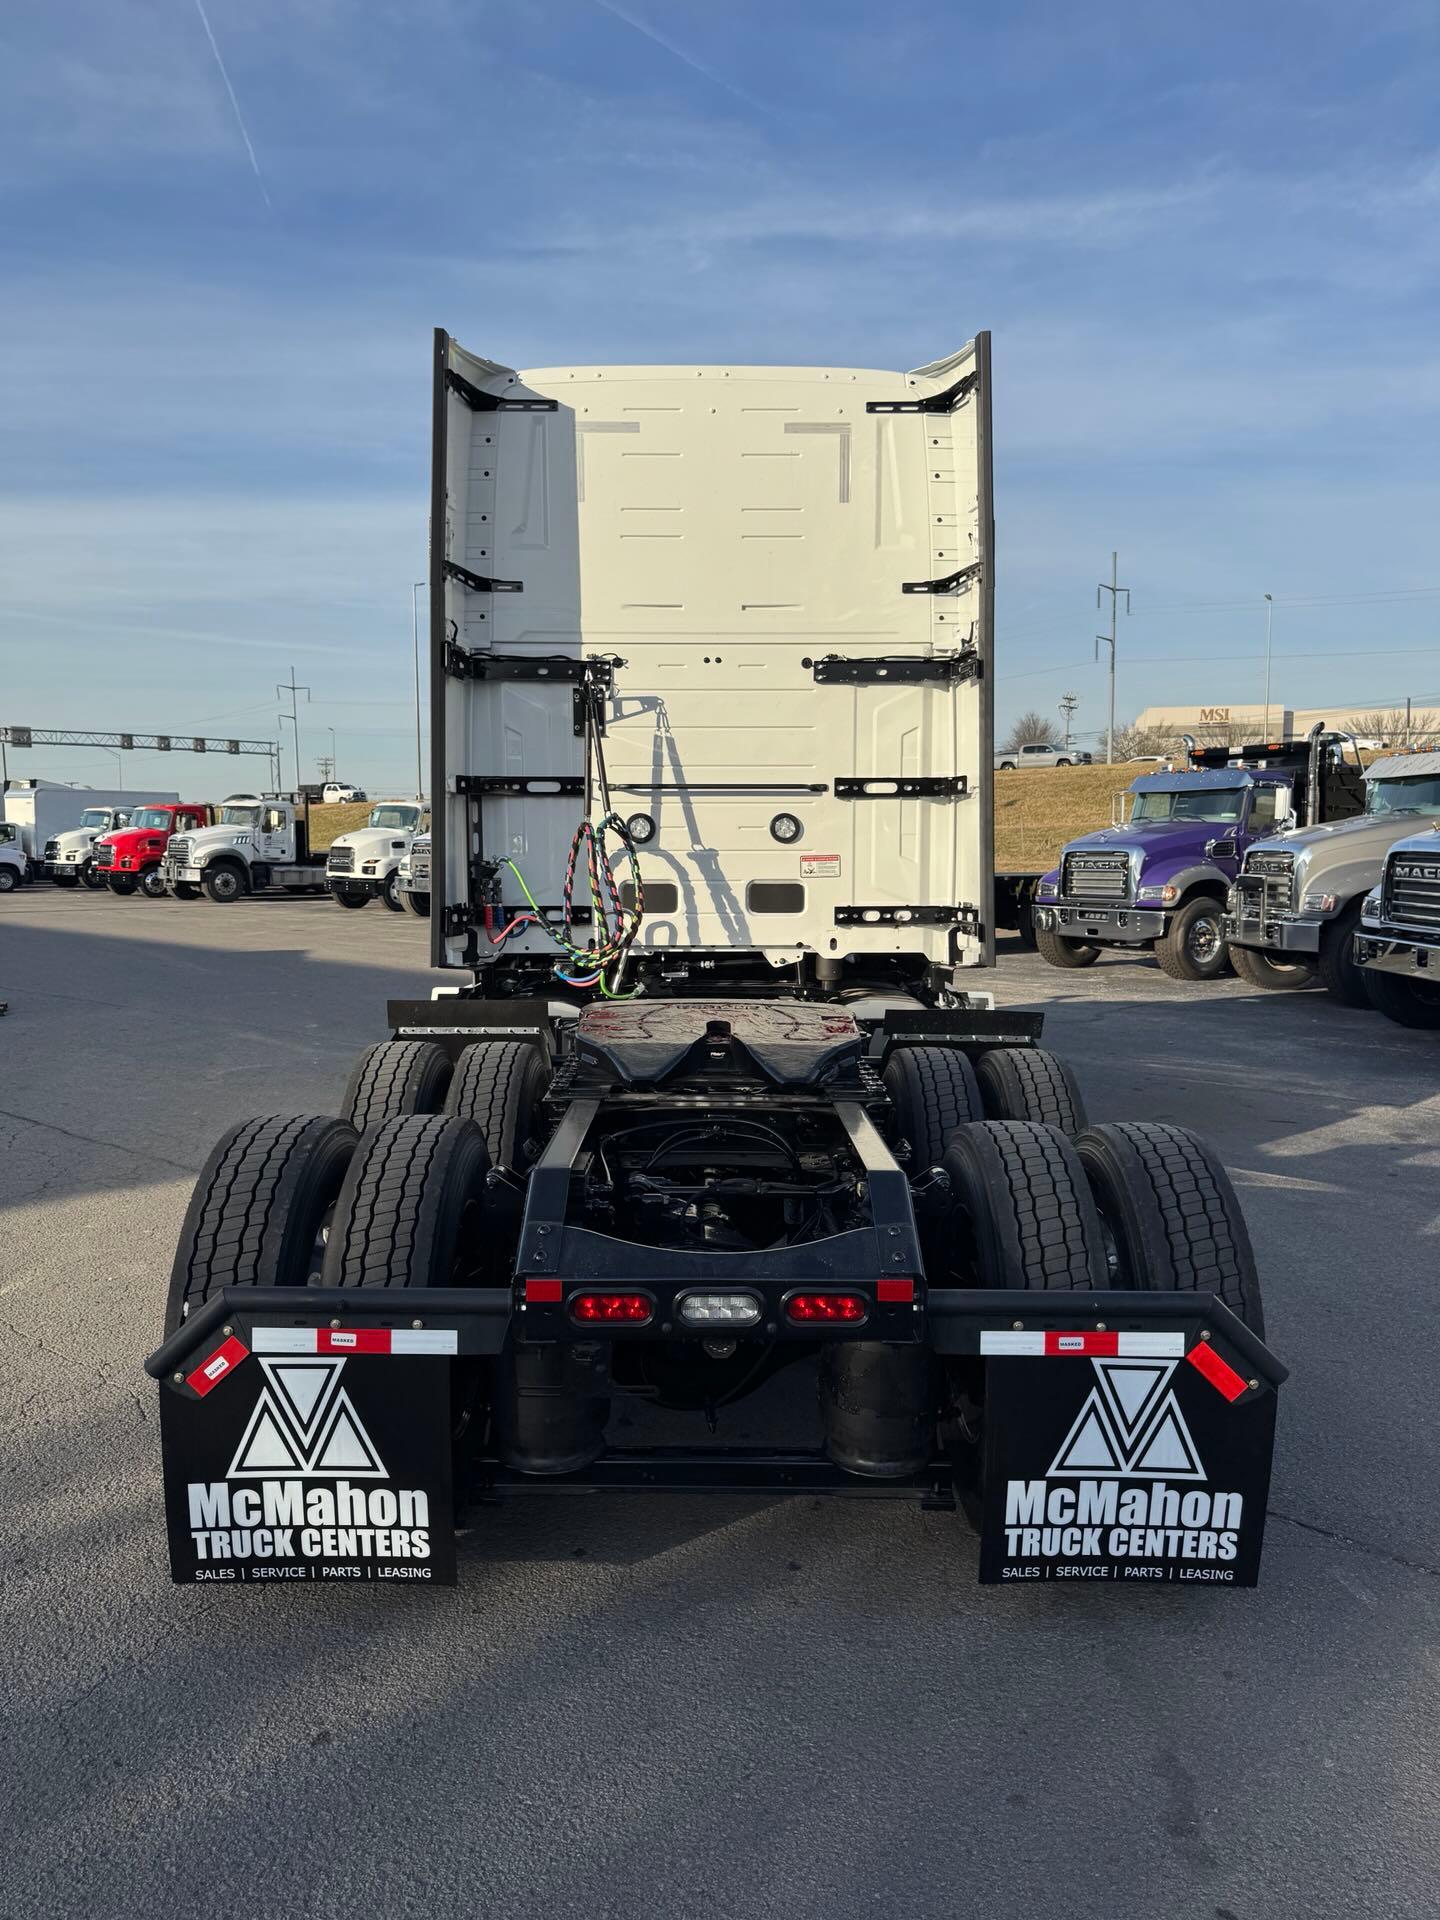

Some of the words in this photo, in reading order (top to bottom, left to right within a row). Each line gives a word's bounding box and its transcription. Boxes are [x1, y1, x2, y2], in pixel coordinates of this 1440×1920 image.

[1199, 708, 1230, 721] MSI
[1395, 867, 1440, 878] MAC
[187, 1481, 430, 1528] McMahon
[1005, 1480, 1243, 1529] McMahon
[191, 1528, 296, 1560] TRUCK
[301, 1528, 431, 1558] CENTERS
[1004, 1527, 1103, 1557] TRUCK
[1108, 1527, 1238, 1560] CENTERS
[195, 1568, 236, 1580] SALES
[252, 1567, 306, 1578] SERVICE
[322, 1567, 361, 1577] PARTS
[378, 1567, 432, 1578] LEASING
[1002, 1567, 1040, 1578] SALES
[1056, 1566, 1109, 1577] SERVICE
[1124, 1567, 1163, 1578] PARTS
[1179, 1568, 1234, 1580] LEASING
